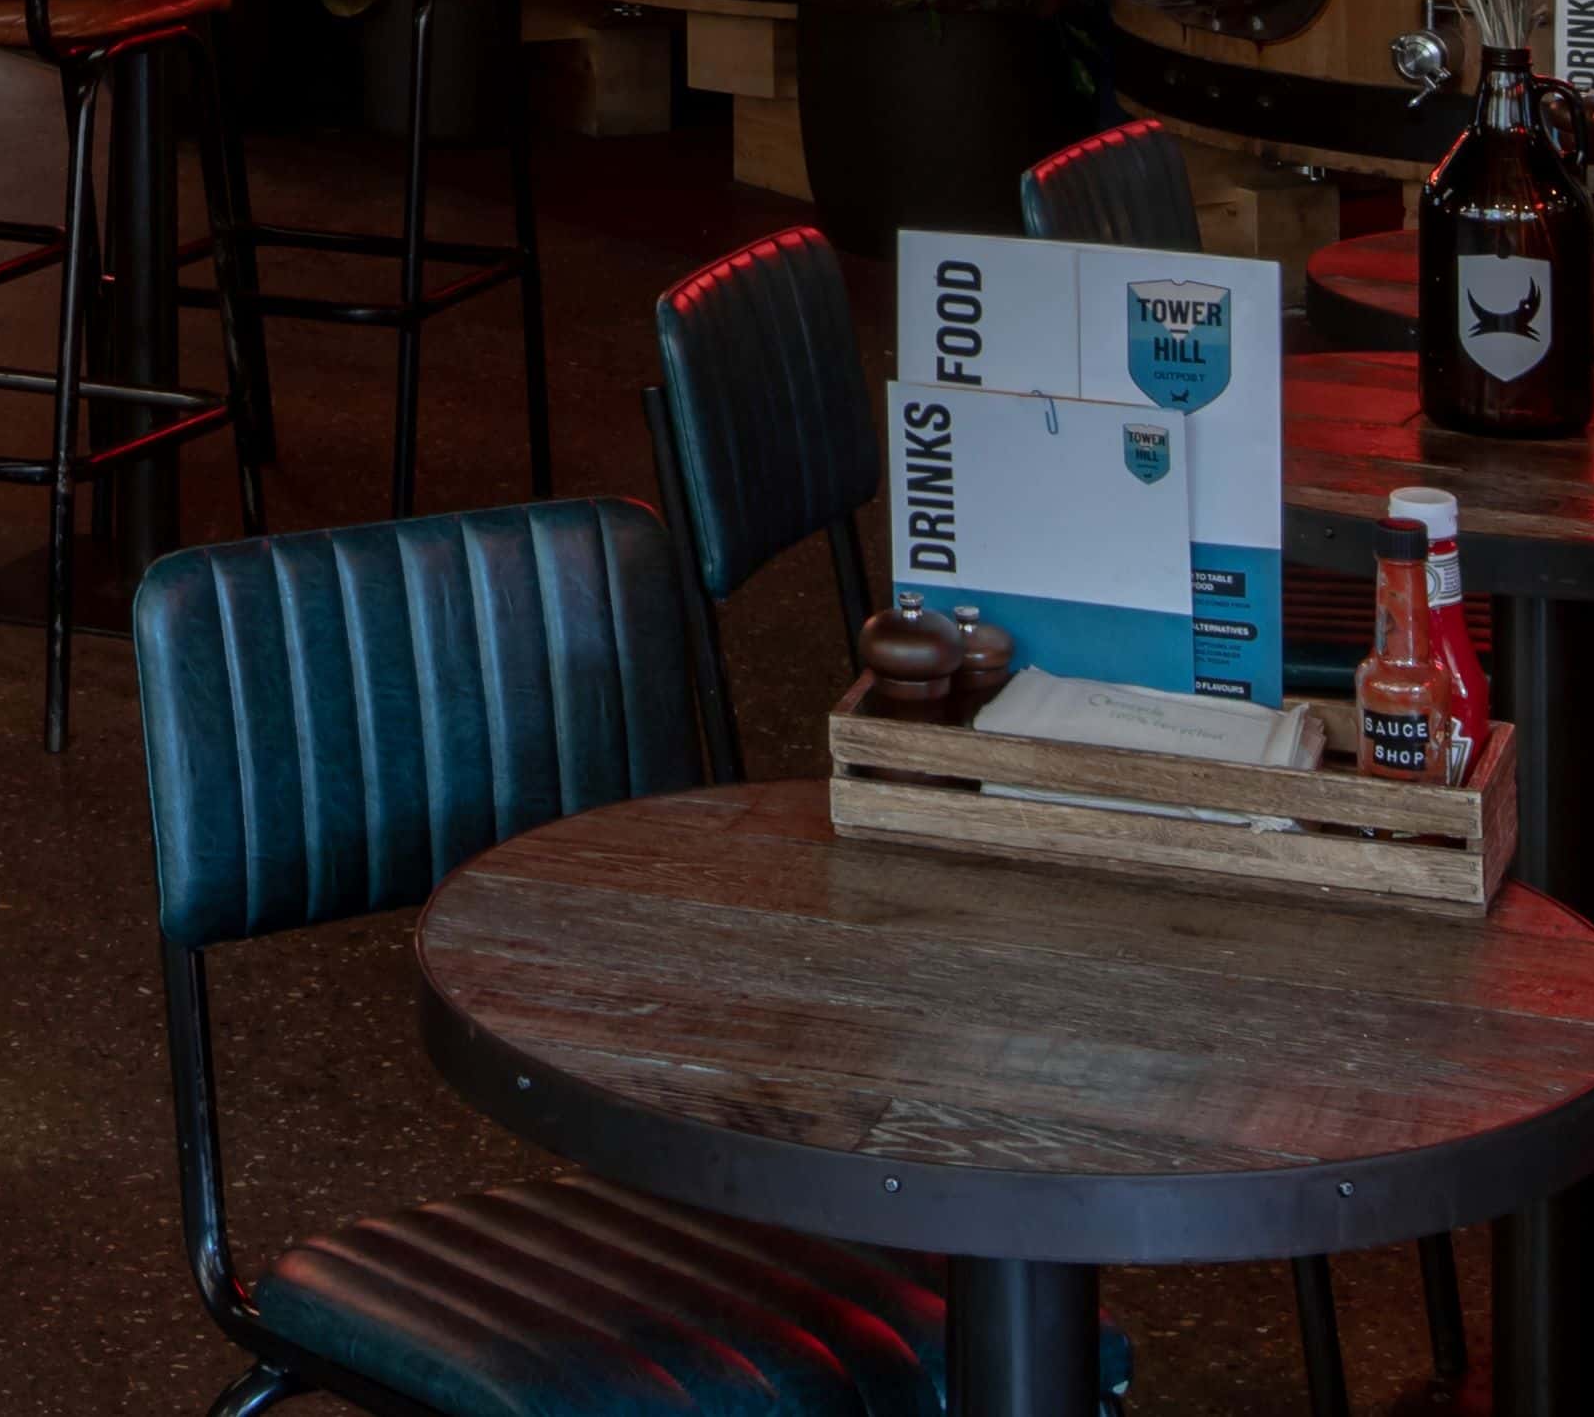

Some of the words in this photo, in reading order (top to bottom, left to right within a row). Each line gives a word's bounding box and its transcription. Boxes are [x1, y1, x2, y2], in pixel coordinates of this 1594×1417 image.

[935, 259, 982, 386] FOOD
[1136, 297, 1223, 326] TOWER
[1153, 337, 1206, 365] HILL
[1127, 431, 1166, 446] TOWER
[1135, 449, 1159, 463] HILL
[903, 401, 957, 574] DRINKS
[1193, 581, 1215, 591] OOD
[1208, 573, 1233, 584] TABLE
[1202, 681, 1245, 695] FLAVOURS
[1364, 716, 1429, 739] SAUCE
[1373, 743, 1425, 766] SHOP
